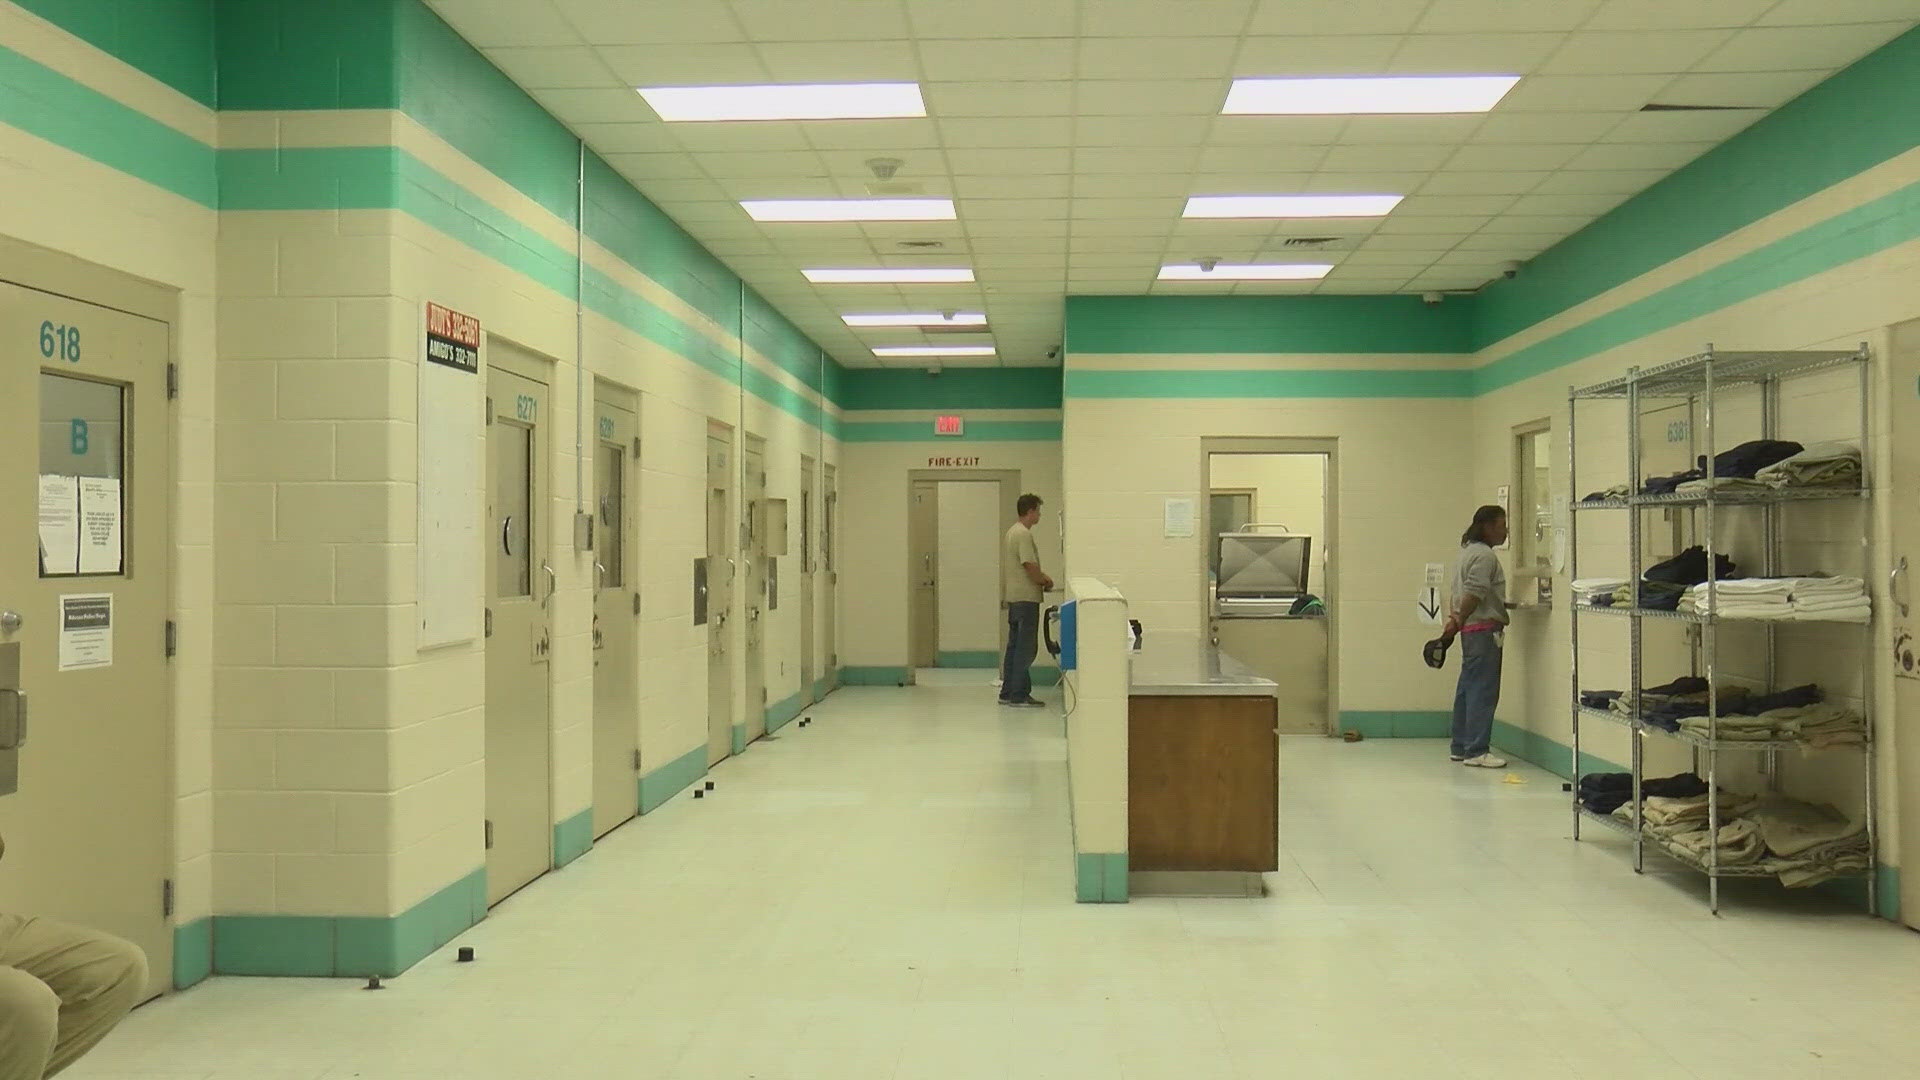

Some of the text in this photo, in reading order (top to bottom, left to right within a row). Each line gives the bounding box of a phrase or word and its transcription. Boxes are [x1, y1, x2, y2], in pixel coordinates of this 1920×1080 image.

[40, 320, 80, 362] 618
[429, 339, 454, 362] AMIGO'S
[517, 395, 537, 422] 6271
[71, 418, 88, 455] B
[939, 416, 960, 433] EXIT
[1667, 420, 1687, 441] 6381
